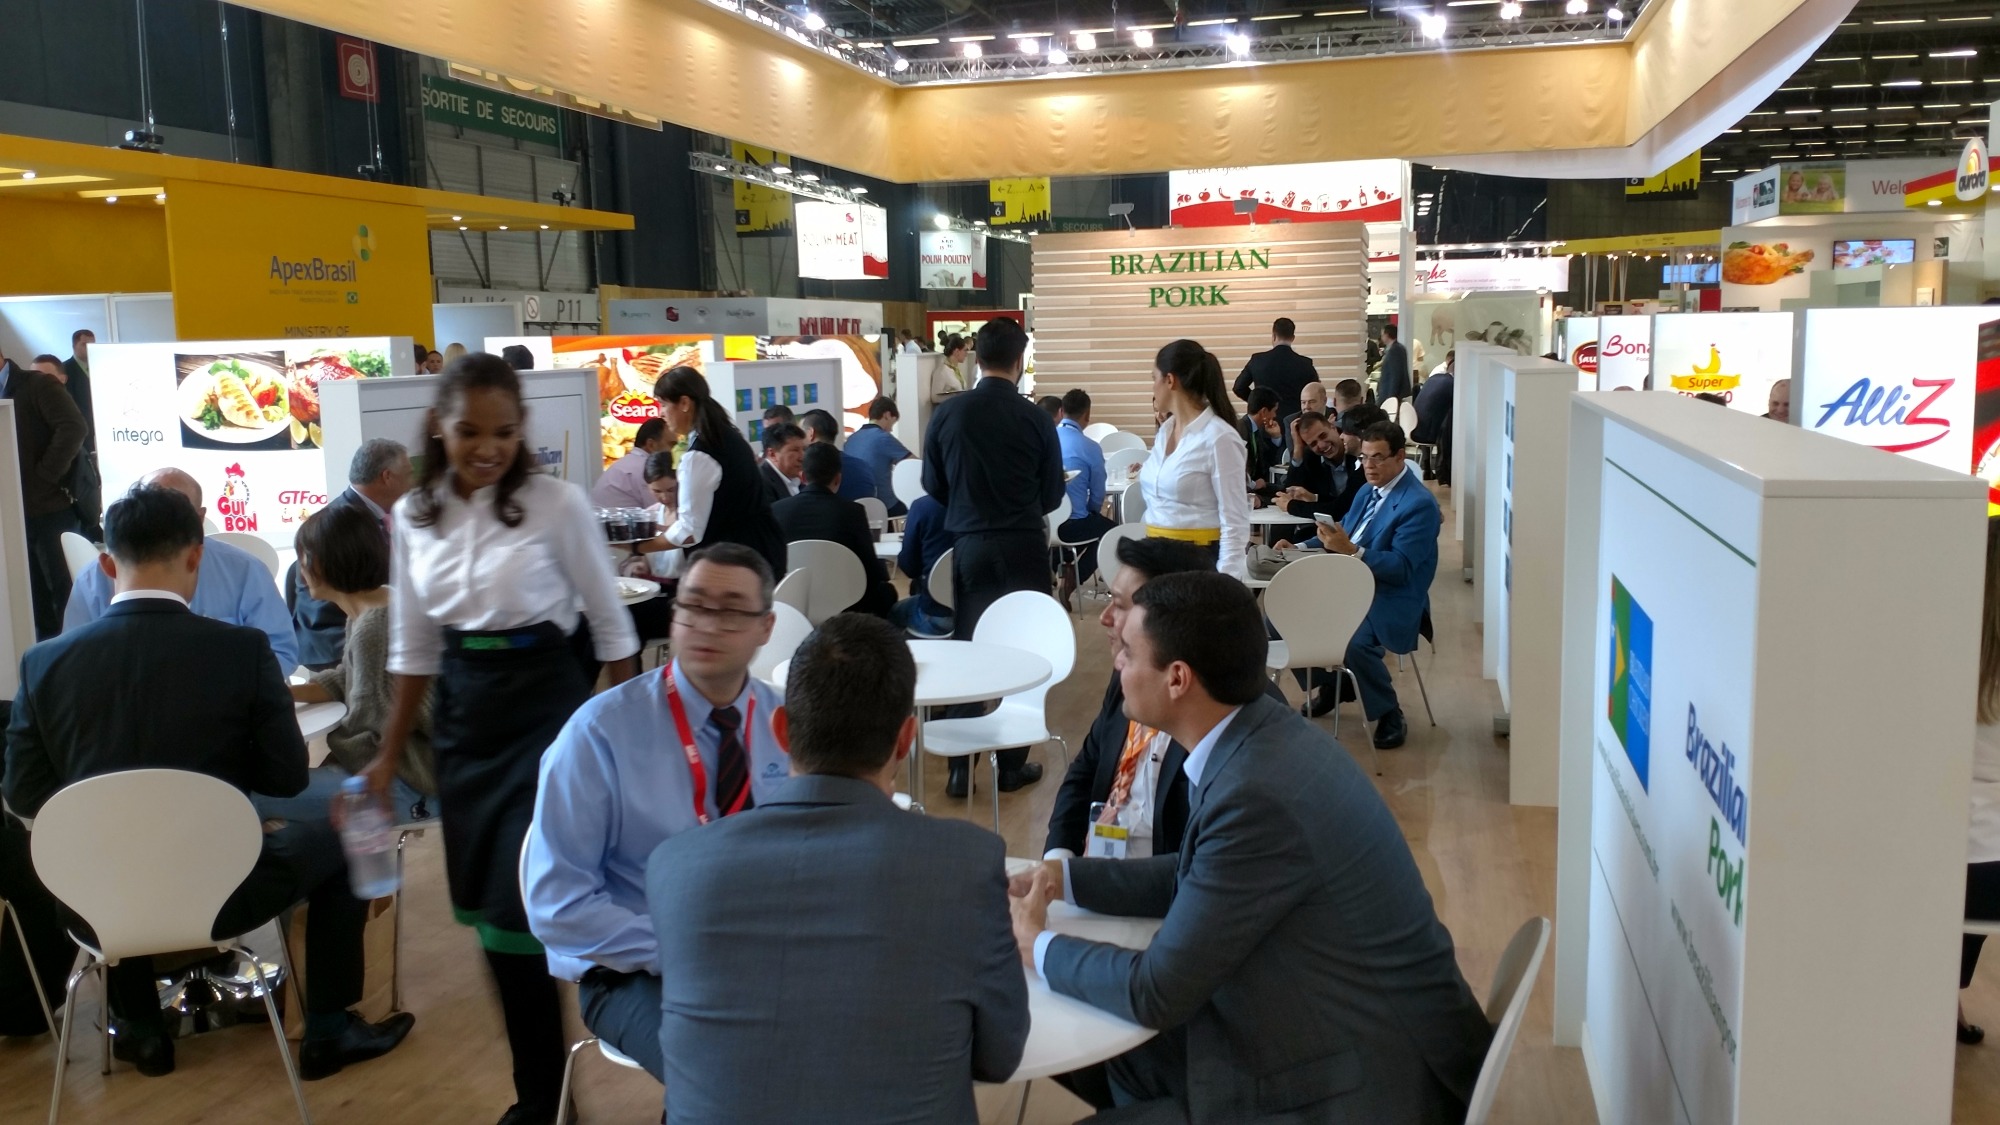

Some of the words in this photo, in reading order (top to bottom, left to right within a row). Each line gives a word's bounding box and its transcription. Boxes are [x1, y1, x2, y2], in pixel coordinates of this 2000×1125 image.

[422, 87, 470, 115] SORTIE
[476, 101, 494, 120] DE
[501, 106, 557, 135] SECOURS
[1958, 170, 1987, 193] aurora
[994, 207, 1002, 217] 6
[1062, 223, 1104, 232] SECOURS
[835, 232, 858, 246] MEAT
[921, 255, 942, 265] POLISH
[943, 255, 971, 265] POULTRY
[1110, 248, 1271, 276] BRAZILIAN
[270, 255, 357, 286] ApexBrasil
[1148, 284, 1230, 308] PORK
[557, 300, 581, 321] P11
[285, 326, 332, 338] MINISTRY
[336, 326, 350, 336] OF
[1688, 377, 1723, 389] Super
[612, 403, 660, 419] Seara
[1814, 377, 1956, 428] AlliZ
[113, 427, 164, 445] integra
[217, 496, 246, 516] GUI
[225, 513, 258, 532] BON
